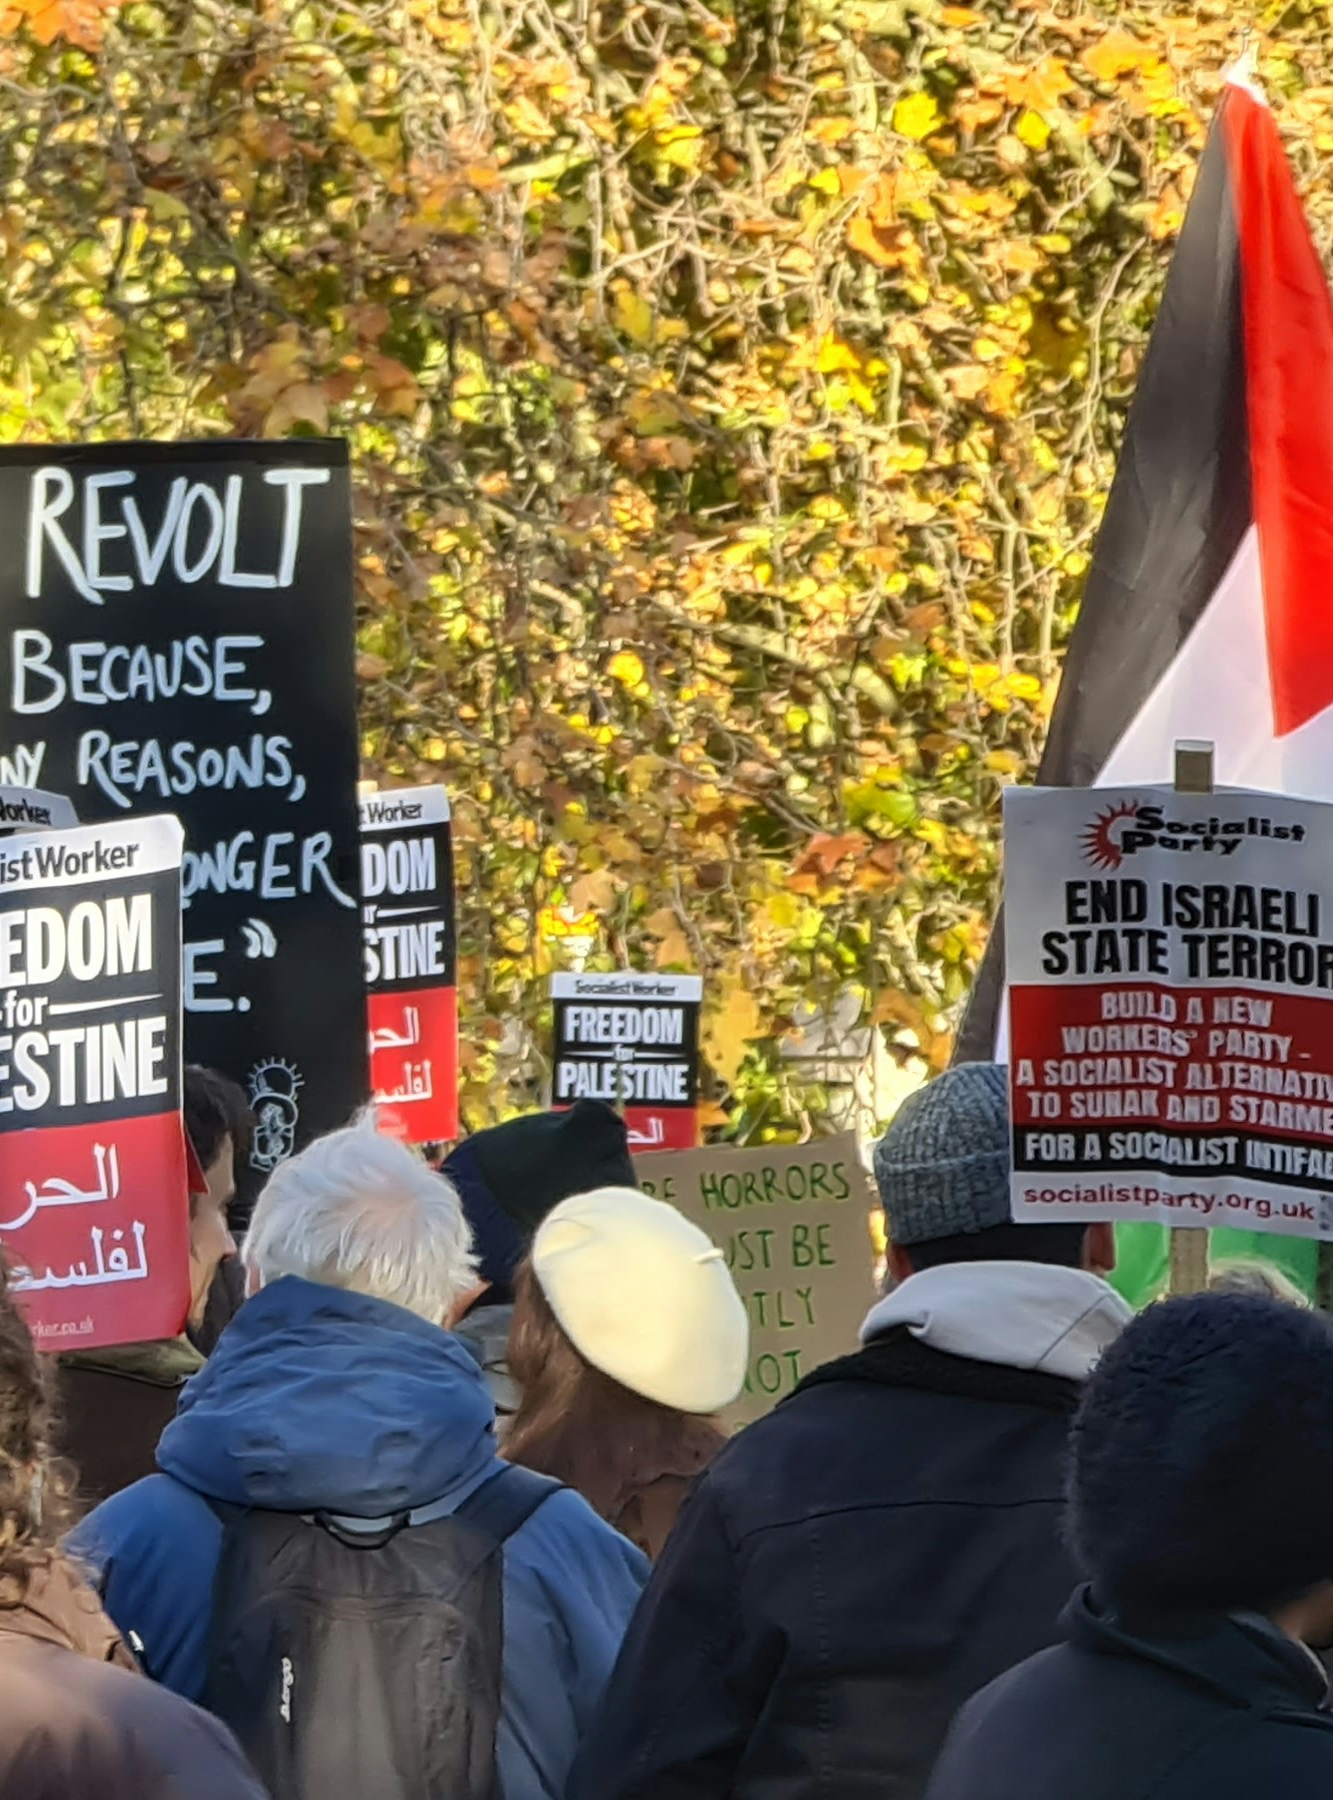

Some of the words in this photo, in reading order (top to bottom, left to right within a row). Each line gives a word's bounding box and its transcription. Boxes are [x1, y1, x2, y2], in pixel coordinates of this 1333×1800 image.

[26, 467, 331, 605] REVOLT
[11, 629, 272, 715] BECAUSE,
[79, 730, 307, 808] REASONS,
[1121, 830, 1242, 855] Party
[1135, 806, 1305, 842] Socialist
[34, 840, 140, 878] Worker
[181, 831, 357, 908] ONGER
[1065, 879, 1148, 925] END
[1162, 882, 1319, 938] ISRAELI
[365, 921, 445, 983] STINE
[1041, 929, 1169, 975] STATE
[1182, 933, 1333, 988] TERROR
[3, 989, 49, 1029] for
[565, 1006, 683, 1044] FREEDOM
[1101, 992, 1177, 1023] BUILD
[1186, 997, 1204, 1024] A
[1213, 996, 1273, 1028] NEW
[1061, 1024, 1197, 1057] WORKERS'
[1208, 1029, 1292, 1063] PARTY
[558, 1062, 689, 1100] PALESTINE
[1016, 1059, 1035, 1086] A
[1044, 1057, 1178, 1089] SOCIALIST
[1185, 1061, 1333, 1103] ALTERNATIV
[1027, 1091, 1061, 1119] TO
[1070, 1089, 1159, 1118] SUNAK
[1166, 1095, 1220, 1123] AND
[1229, 1094, 1333, 1135] STARME
[1025, 1133, 1075, 1161] FOR
[1084, 1133, 1103, 1161] A
[1109, 1132, 1239, 1166] SOCIALIST
[1245, 1139, 1333, 1180] INTIFA
[699, 1162, 850, 1209] HORRORS
[1024, 1183, 1315, 1221] socialistparty.org.uk
[792, 1224, 836, 1267] BE
